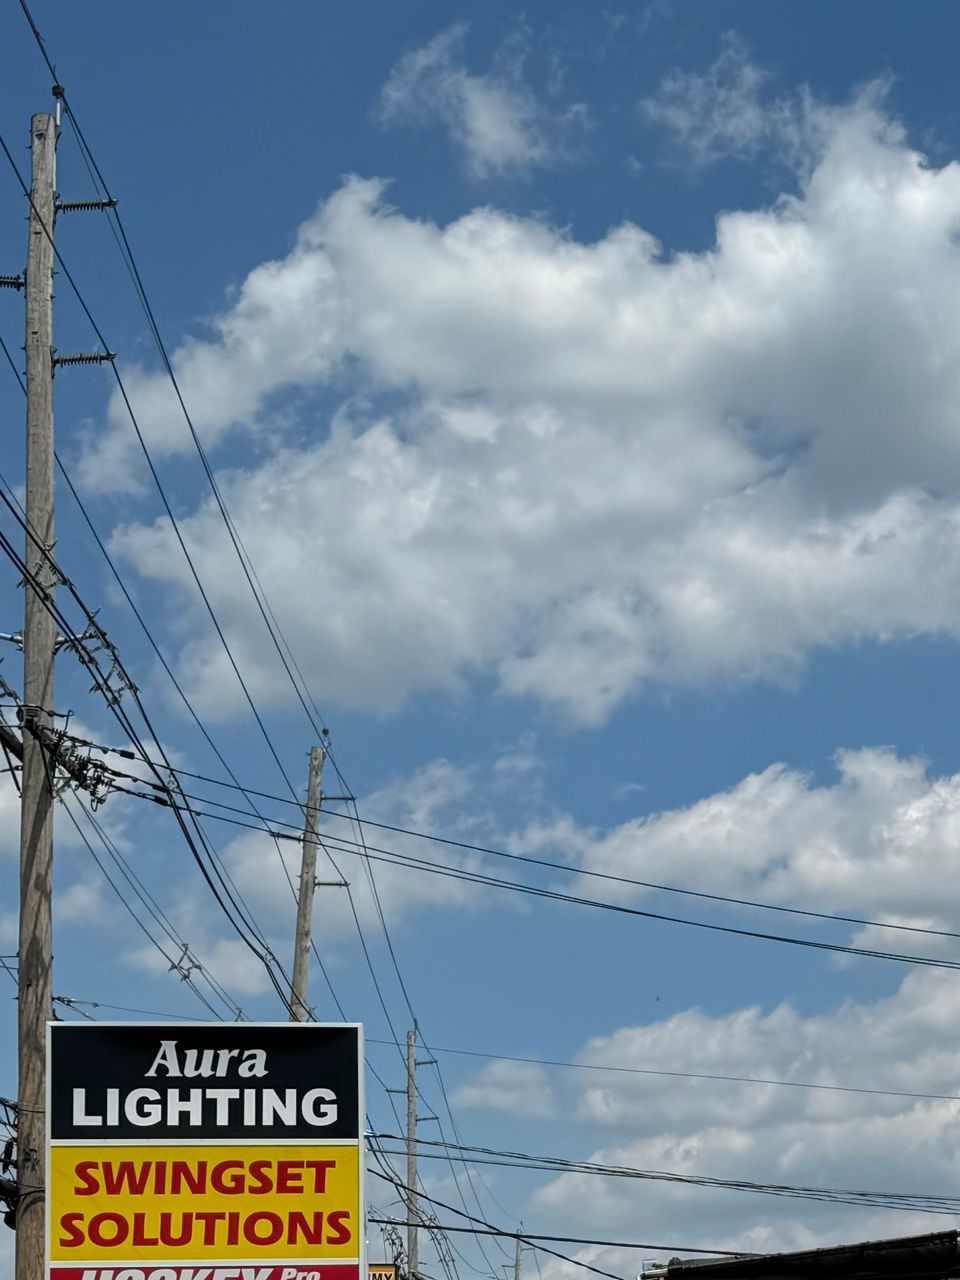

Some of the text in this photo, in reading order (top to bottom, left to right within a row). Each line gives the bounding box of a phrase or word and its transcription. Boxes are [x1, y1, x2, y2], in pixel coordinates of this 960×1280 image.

[144, 1040, 269, 1078] Aura
[72, 1087, 338, 1127] LIGHTING
[73, 1160, 337, 1196] SWINGSET
[59, 1210, 352, 1248] SOLUTIONS
